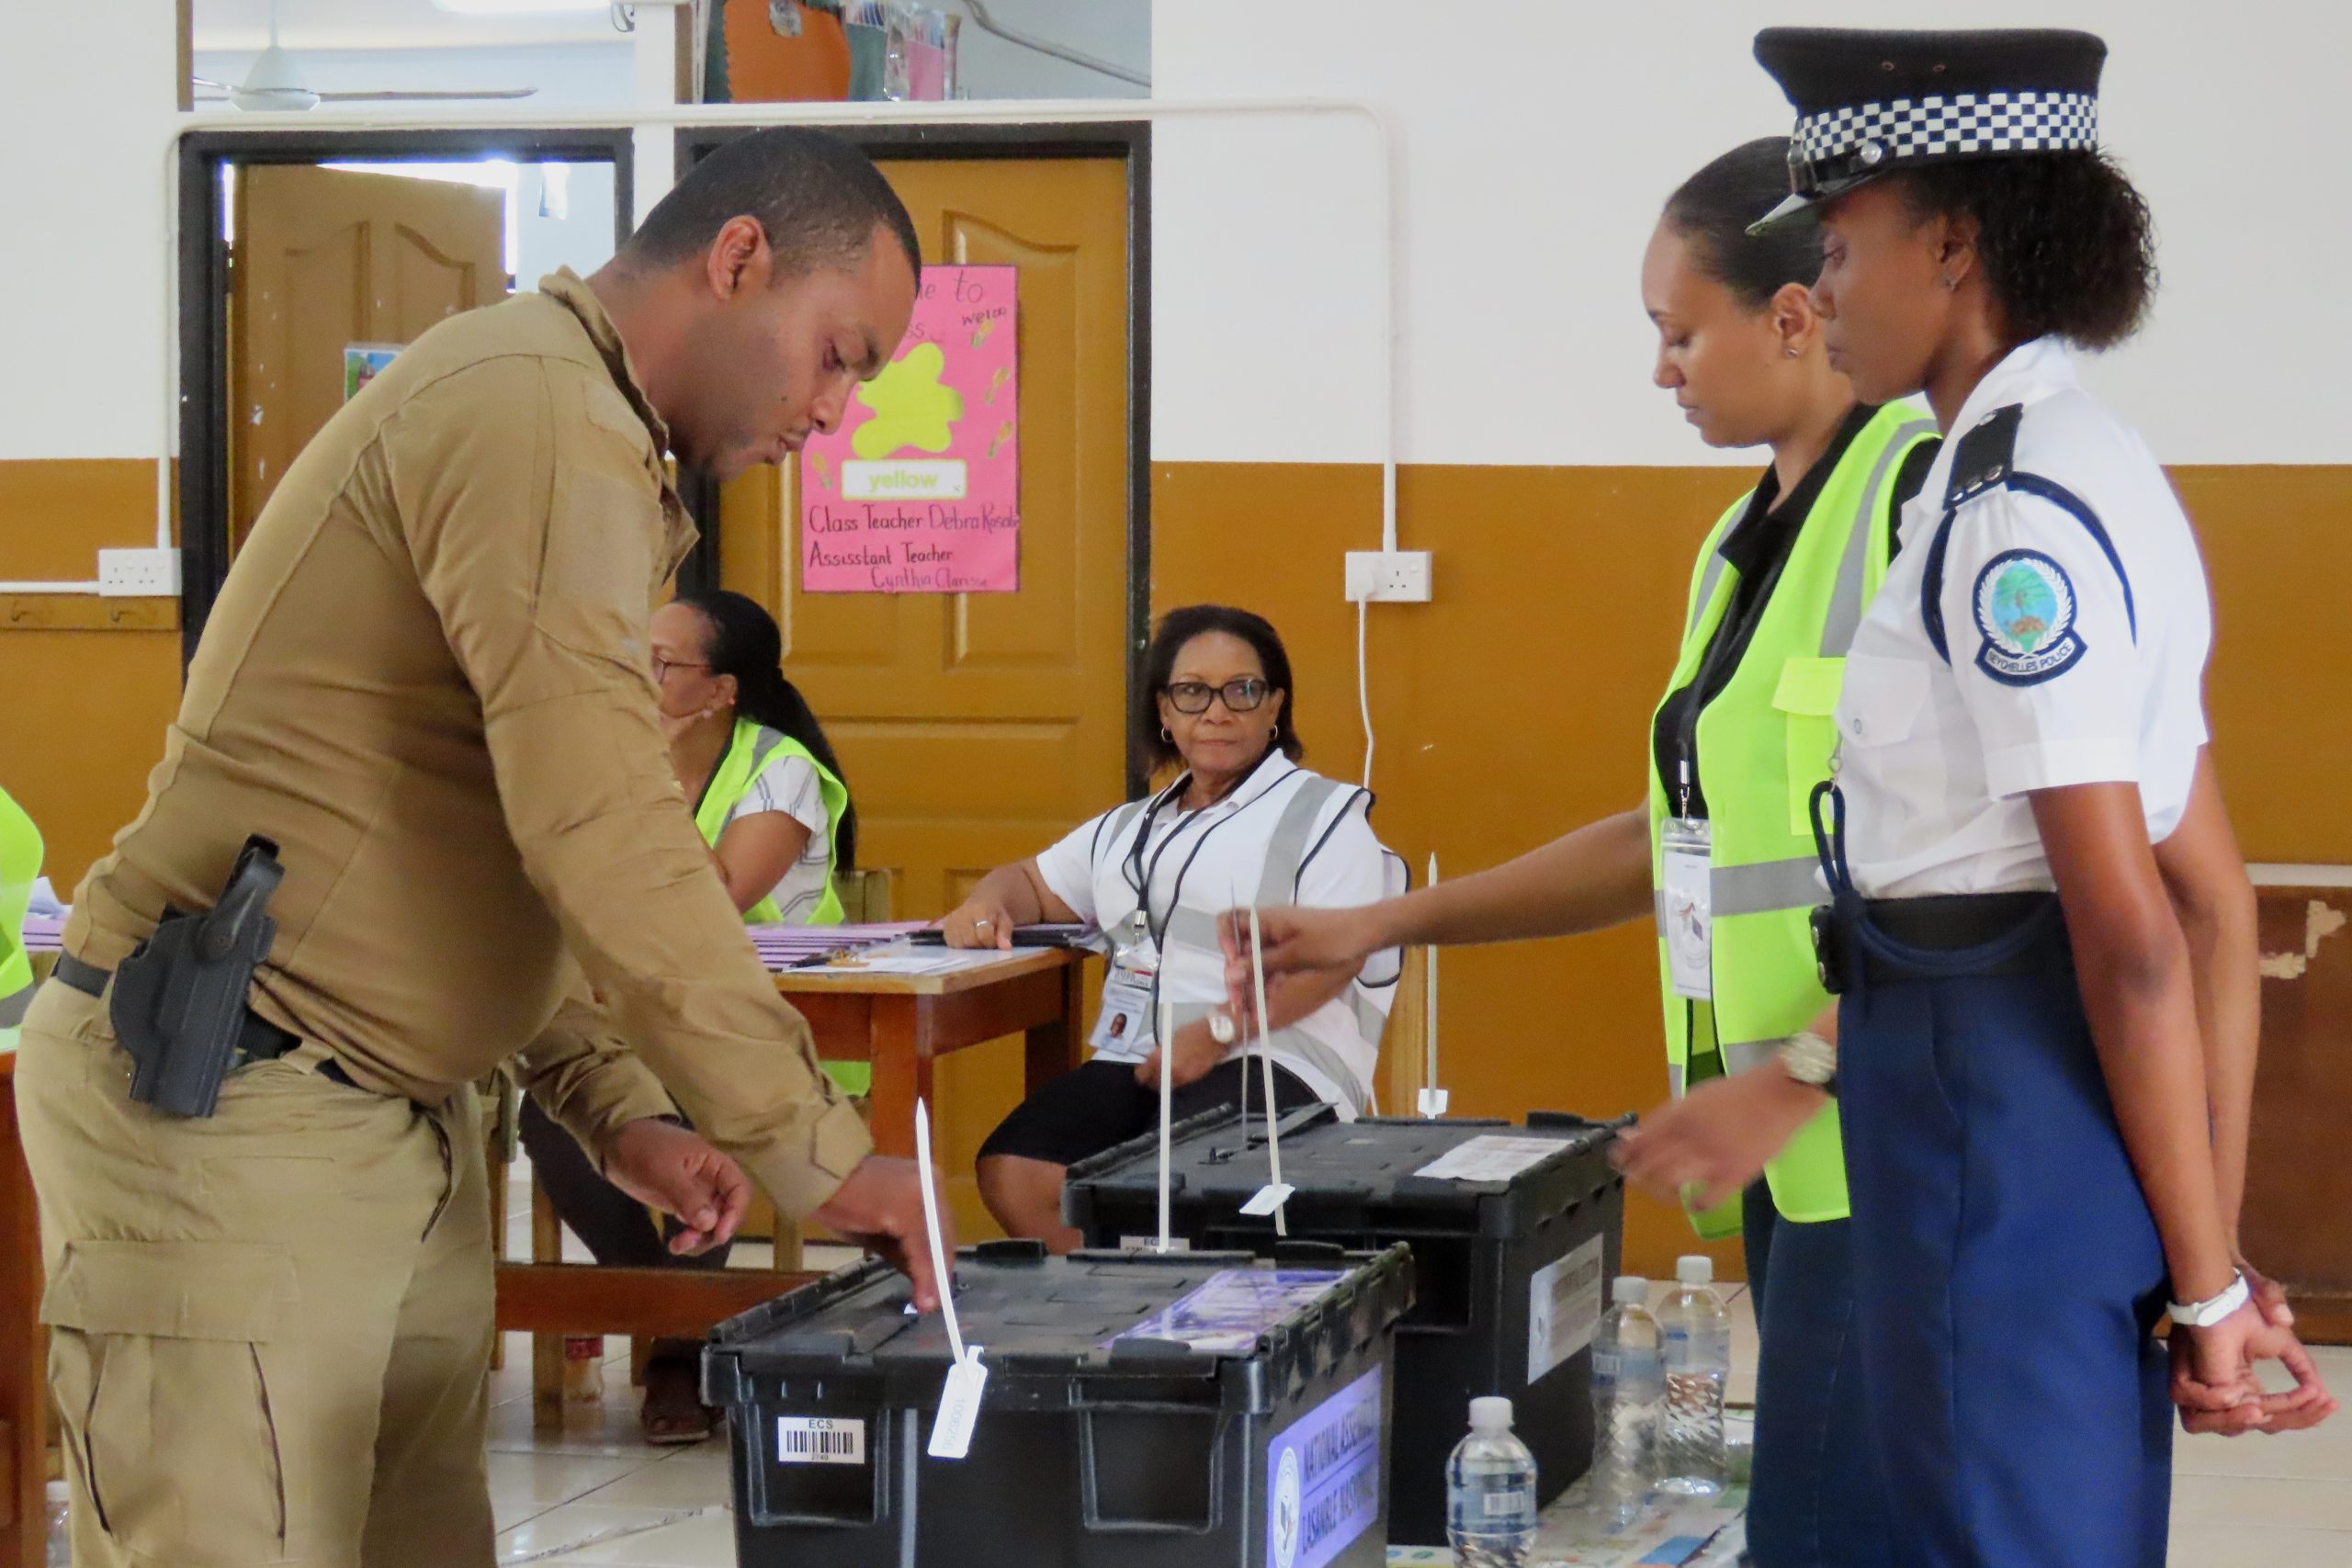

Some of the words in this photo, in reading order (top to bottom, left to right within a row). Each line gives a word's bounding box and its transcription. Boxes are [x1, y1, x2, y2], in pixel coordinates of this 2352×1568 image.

[954, 269, 983, 303] to
[867, 469, 938, 492] yellow
[809, 505, 859, 534] Class
[863, 504, 923, 530] Teacher
[928, 504, 978, 530] Debra
[901, 542, 953, 563] Teacher
[1987, 650, 2038, 671] SEYCHELLES
[2040, 643, 2073, 669] POLICE
[808, 1419, 833, 1429] ECS
